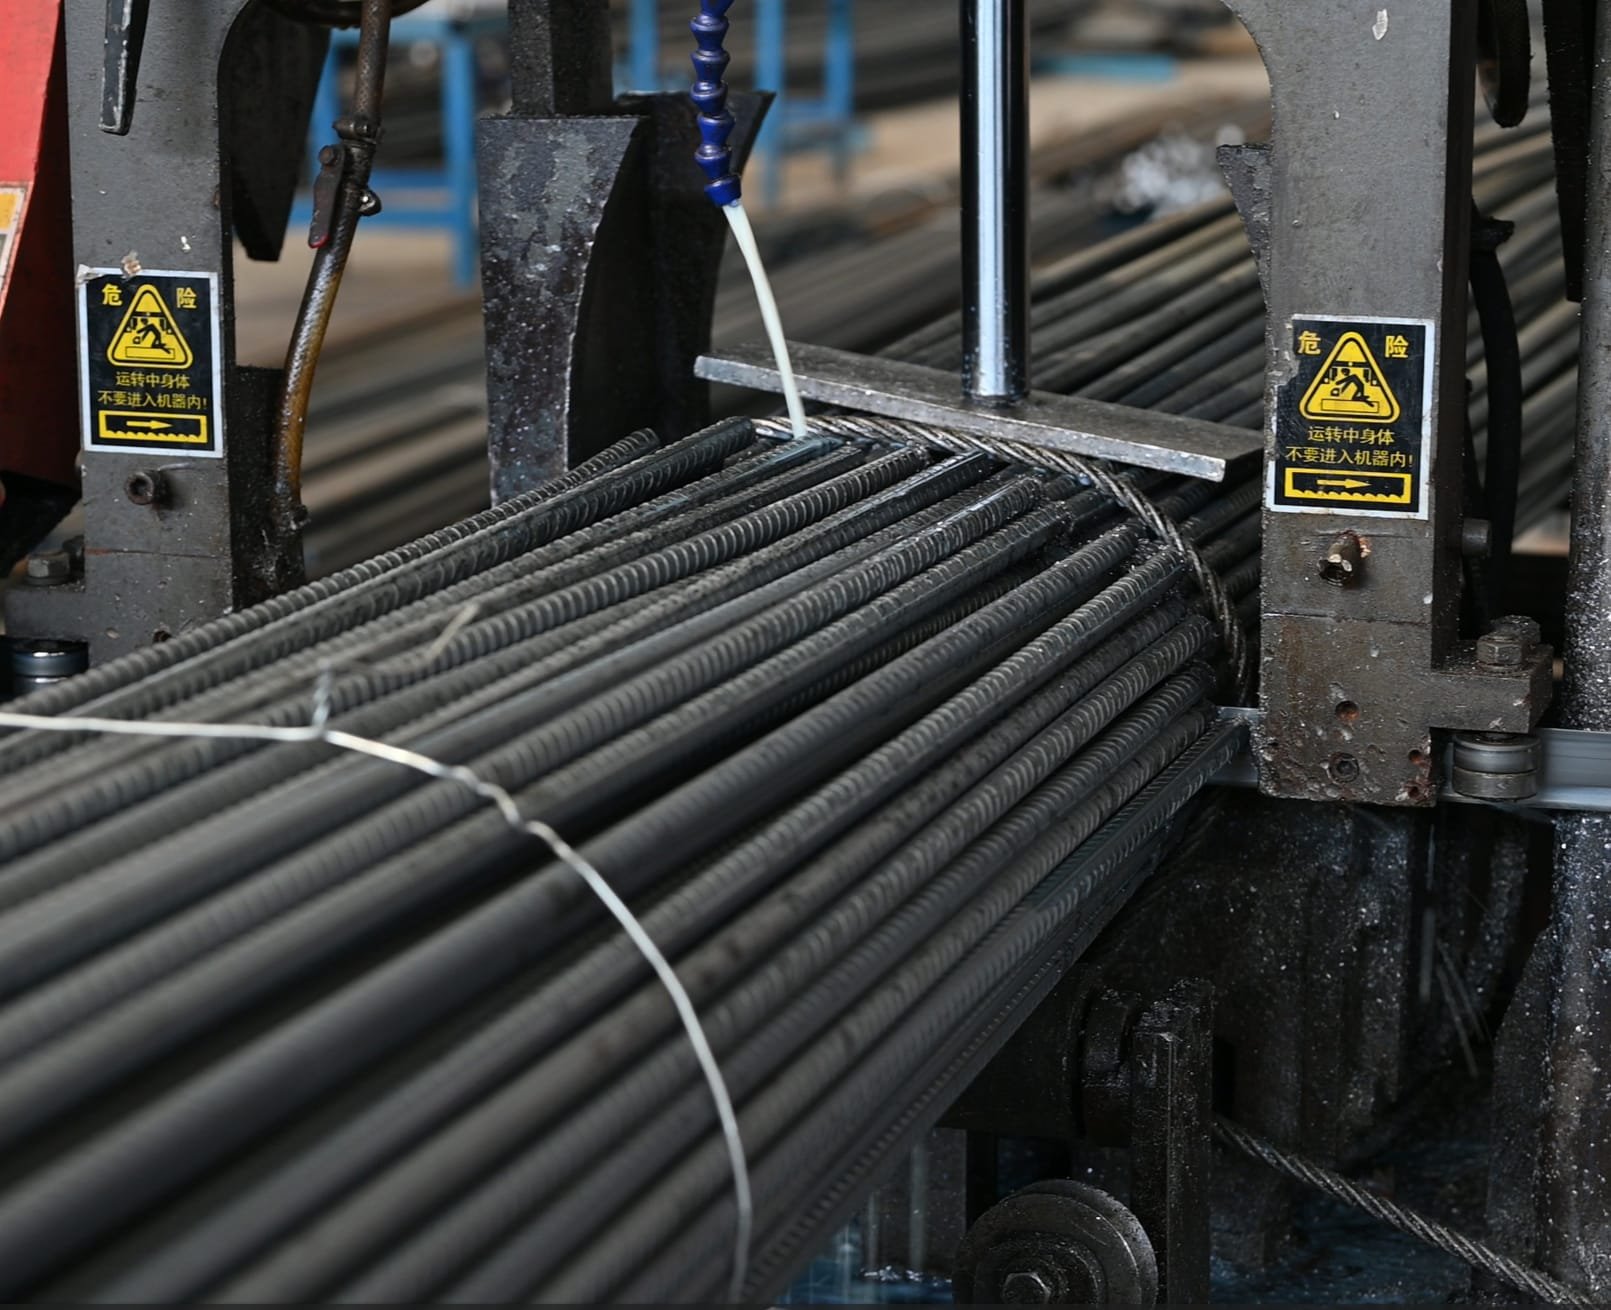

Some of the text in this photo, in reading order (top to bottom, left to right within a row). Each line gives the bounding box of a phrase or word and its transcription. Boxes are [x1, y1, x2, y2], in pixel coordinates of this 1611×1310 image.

[102, 283, 198, 309] 危 险
[1298, 330, 1409, 358] 危 险
[115, 371, 191, 389] 运转中身体
[97, 390, 208, 410] 不要进入机器内!
[1307, 426, 1396, 446] 运转中身体
[1285, 446, 1414, 468] 不要进入机器内!
